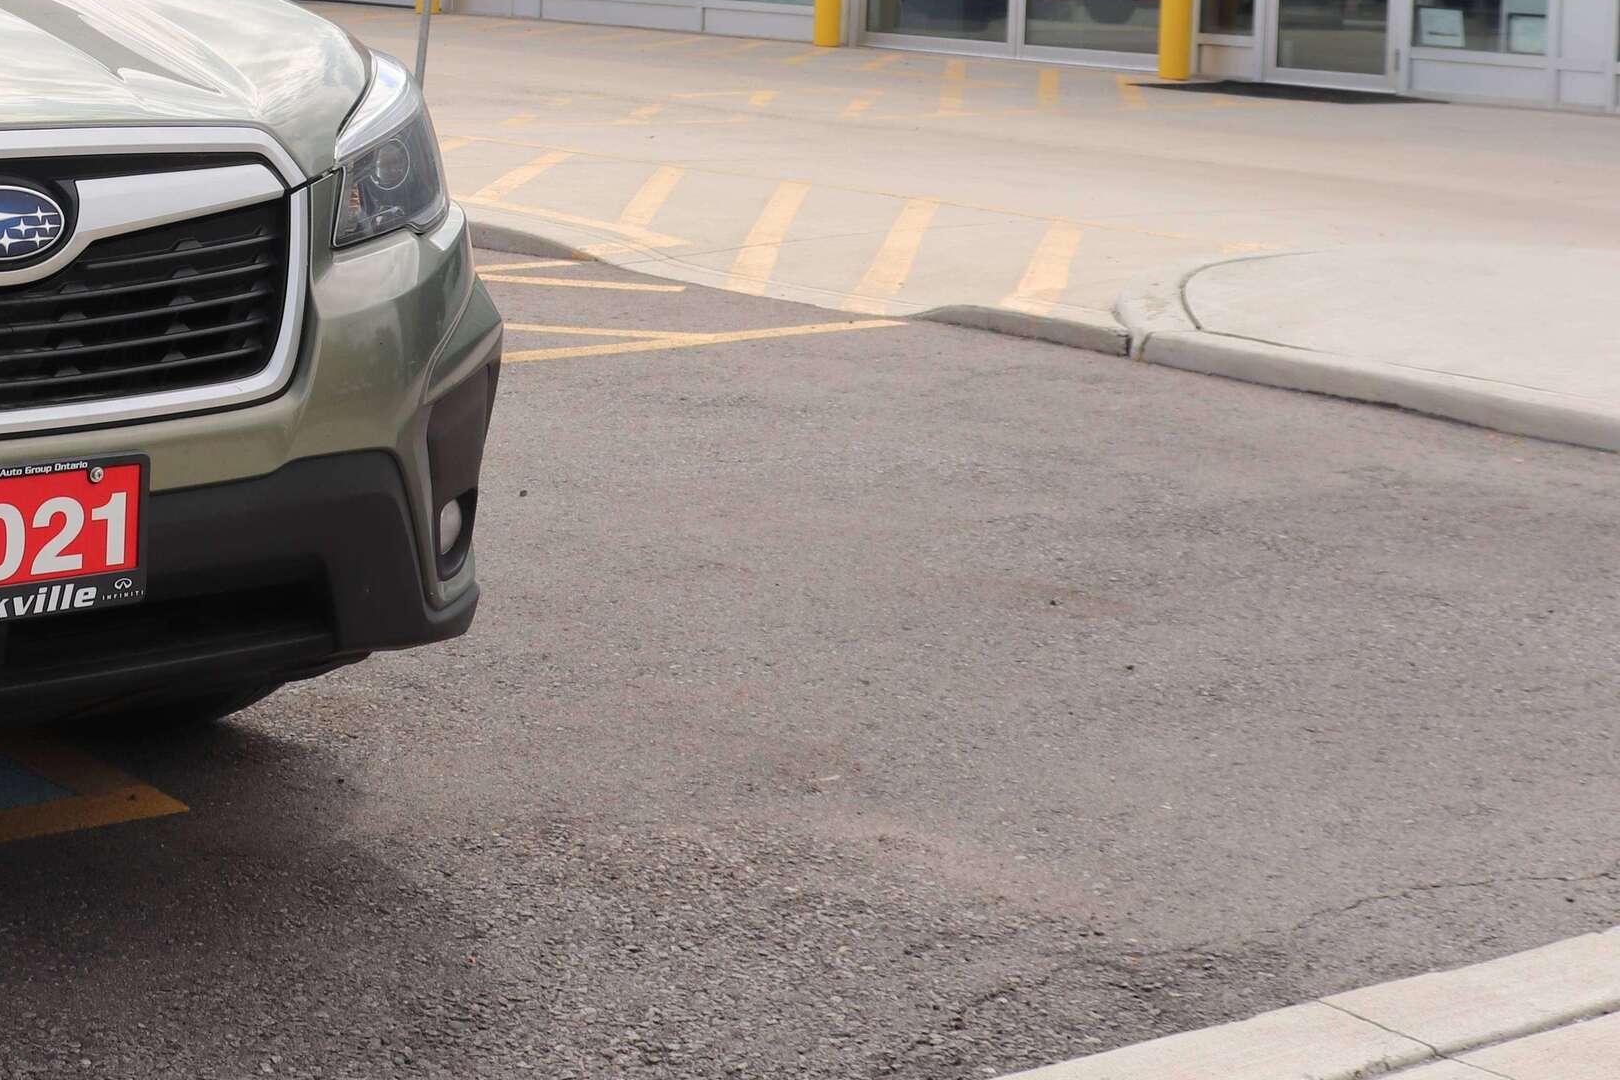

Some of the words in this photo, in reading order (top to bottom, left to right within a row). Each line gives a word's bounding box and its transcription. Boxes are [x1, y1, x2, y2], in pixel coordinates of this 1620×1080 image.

[0, 467, 23, 478] Auto
[25, 464, 52, 476] Group
[54, 460, 88, 472] Ontario
[102, 589, 144, 601] INFINITI
